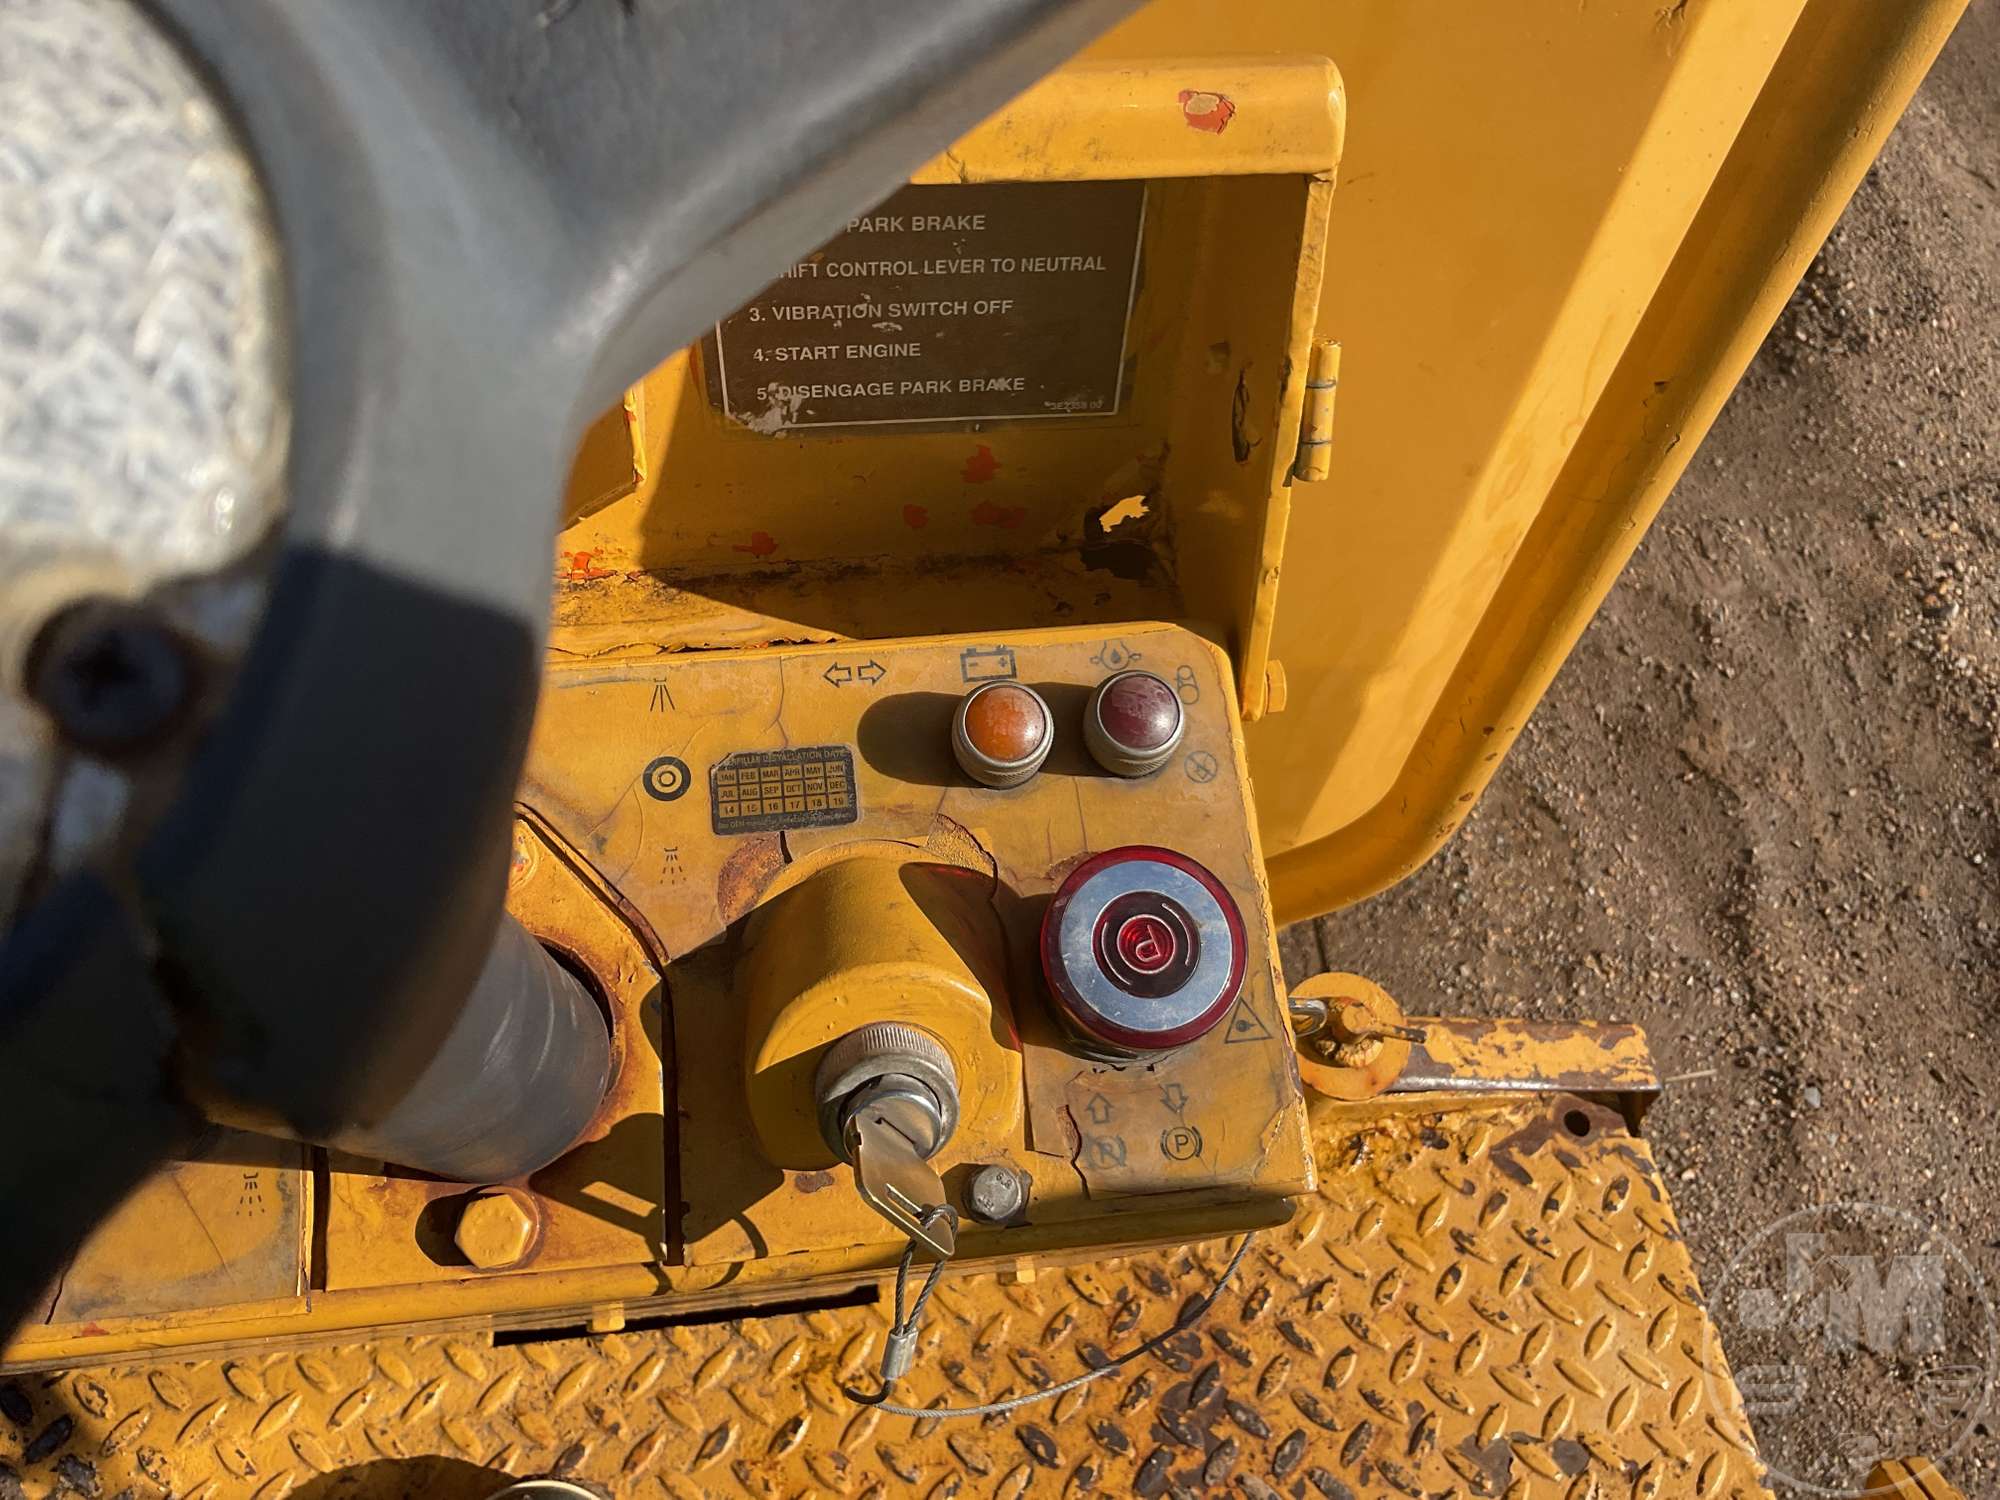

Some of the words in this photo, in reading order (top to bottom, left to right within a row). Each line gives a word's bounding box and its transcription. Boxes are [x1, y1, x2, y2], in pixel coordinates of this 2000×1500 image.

[847, 216, 904, 233] PARK
[912, 215, 986, 231] BRAKE
[827, 261, 919, 277] CONTROL
[924, 259, 985, 275] LEVER
[991, 258, 1016, 273] TO
[1021, 256, 1106, 272] NEUTRAL
[749, 307, 766, 322] 3.
[771, 303, 882, 321] VIBRATION
[888, 301, 968, 318] SWITCH
[974, 300, 1014, 316] OFF
[753, 347, 769, 362] 4.
[775, 345, 840, 362] START
[846, 343, 921, 360] ENGINE
[777, 381, 894, 400] DISENGAGE
[901, 379, 953, 395] PARK
[959, 378, 1025, 394] BRAKE
[763, 769, 779, 779] MAR
[806, 766, 821, 775] MAY
[742, 788, 758, 797] AUG
[764, 786, 779, 795] SEP
[786, 784, 801, 793] OCT
[807, 782, 823, 791] NOV
[829, 780, 845, 790] DEC
[724, 805, 734, 814] 14
[768, 802, 779, 811] 16
[790, 800, 800, 809] 17
[812, 799, 823, 808] 18
[833, 796, 844, 806] 19
